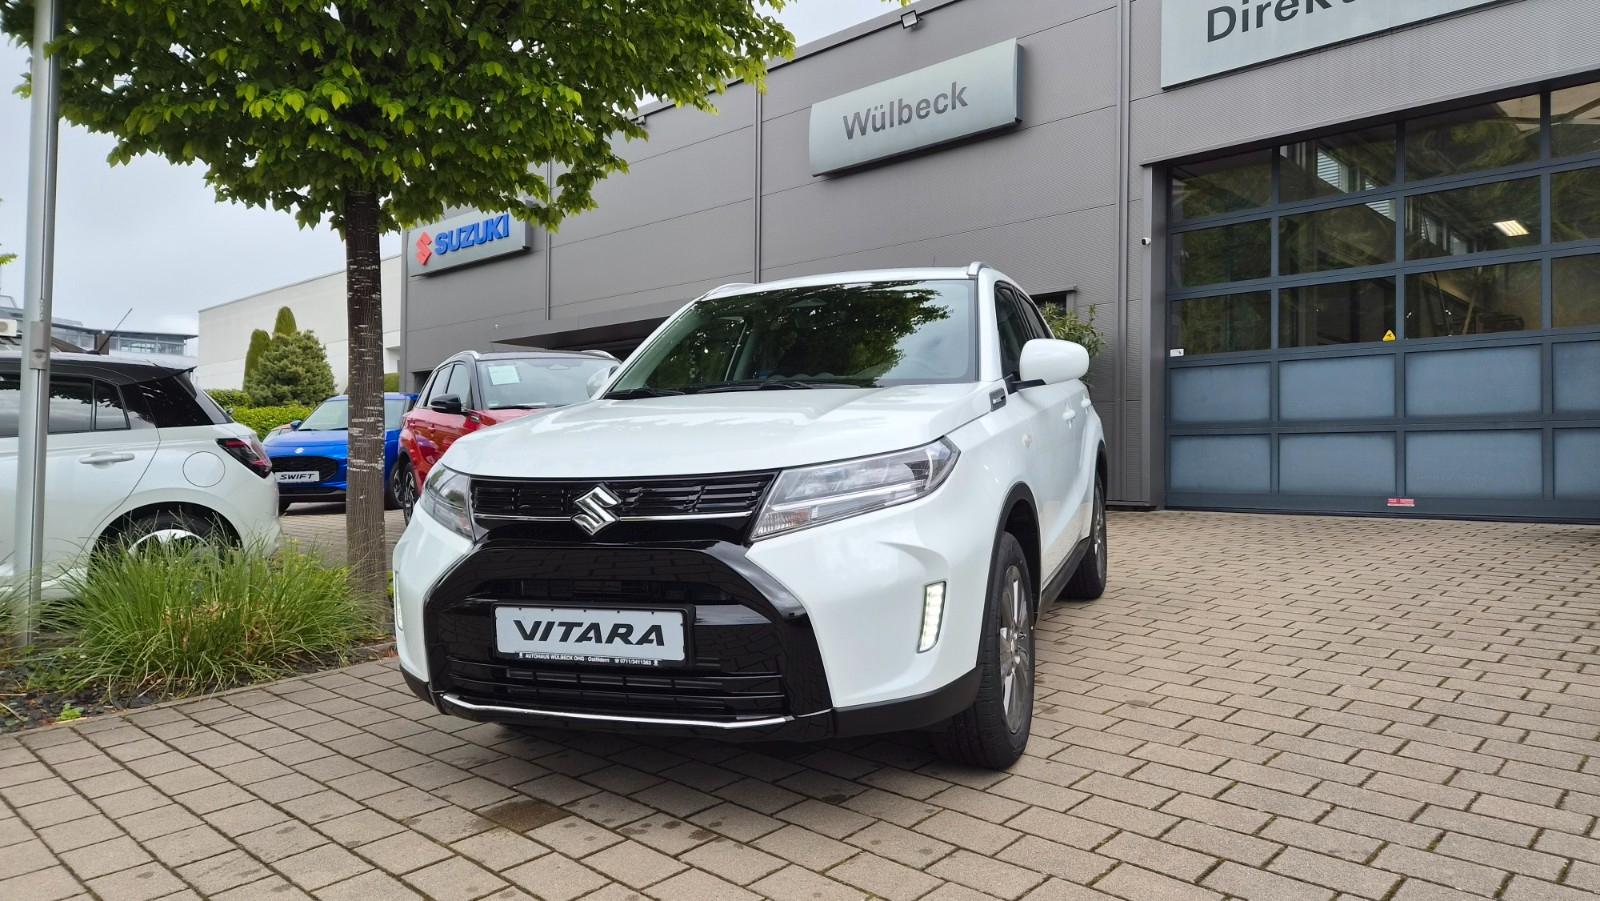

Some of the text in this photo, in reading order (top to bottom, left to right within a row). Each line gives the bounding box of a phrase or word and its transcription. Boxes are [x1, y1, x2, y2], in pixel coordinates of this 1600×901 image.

[1207, 0, 1355, 43] Dire
[842, 81, 969, 140] Wülbeck
[434, 213, 510, 256] SUZUKI
[513, 619, 665, 647] VITARA
